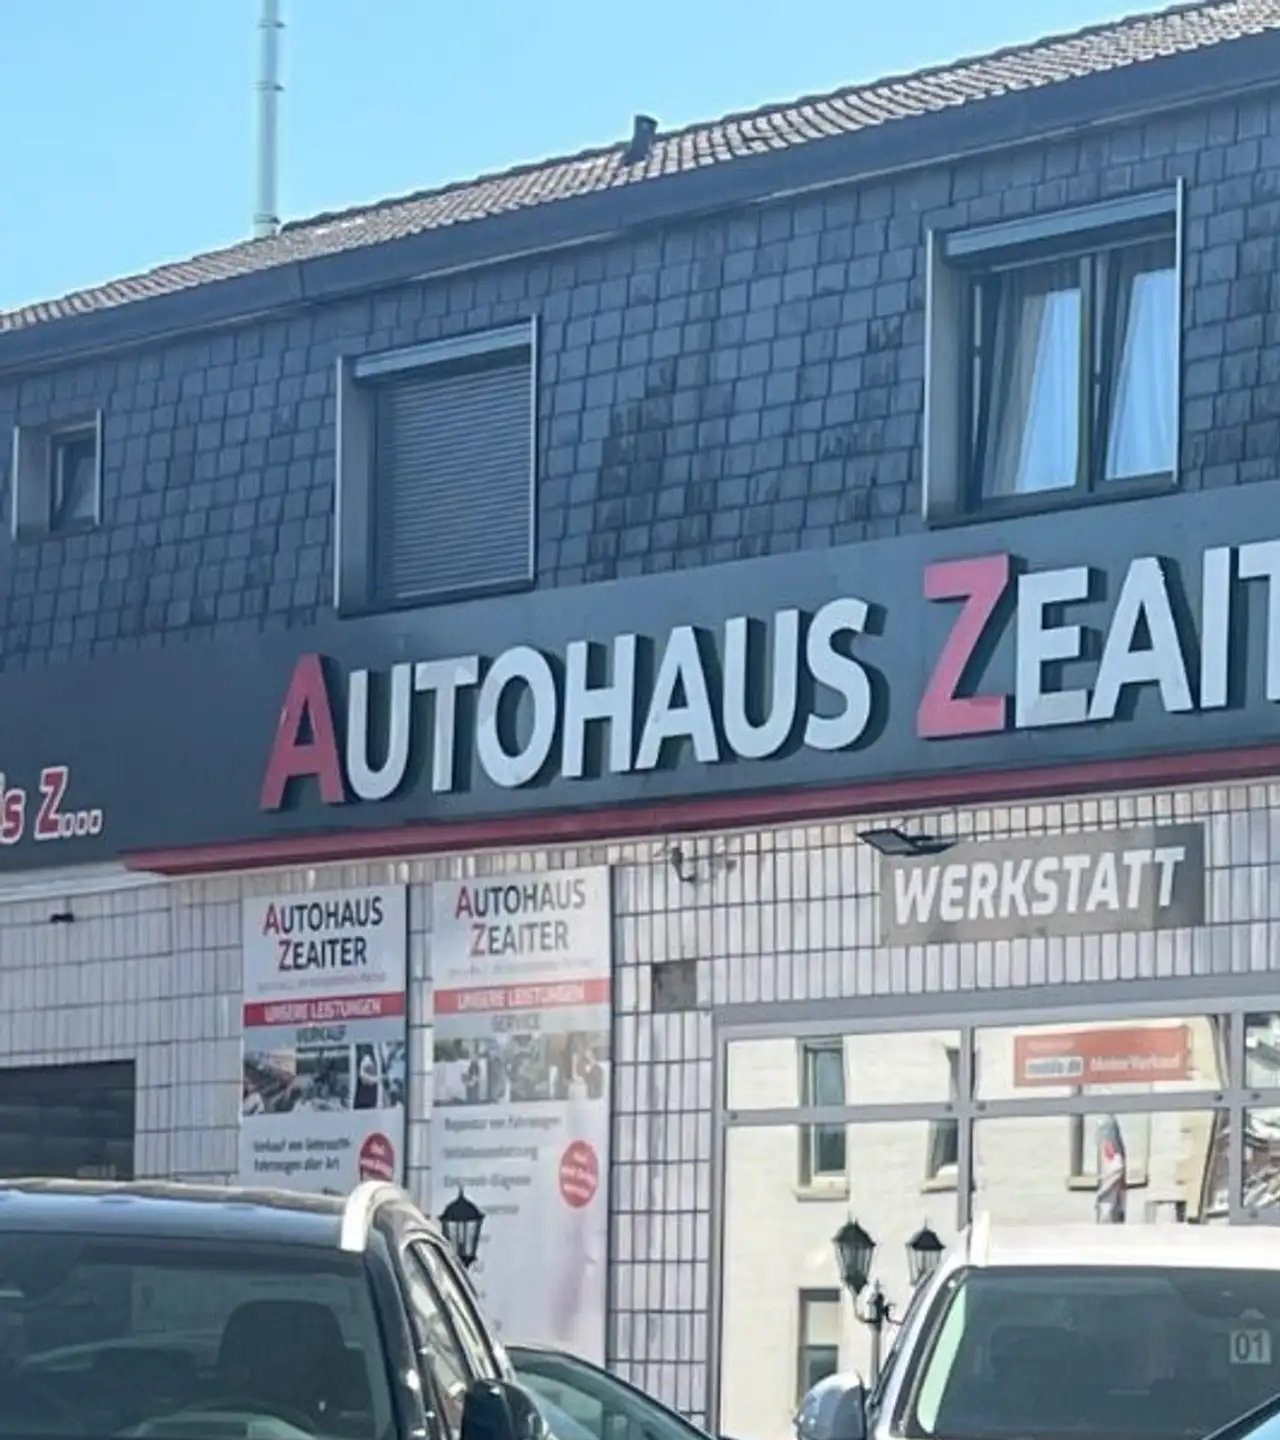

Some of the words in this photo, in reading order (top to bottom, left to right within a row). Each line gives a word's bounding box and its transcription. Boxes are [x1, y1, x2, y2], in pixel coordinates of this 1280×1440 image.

[258, 597, 872, 812] AUTOHAUS
[455, 879, 586, 919] AUTOHAUS
[893, 846, 1186, 925] WERKSTATT
[262, 896, 383, 937] AUTOHAUS
[278, 936, 368, 972] ZEAITER
[470, 920, 569, 957] ZEAITER
[1235, 1332, 1263, 1361] 01
